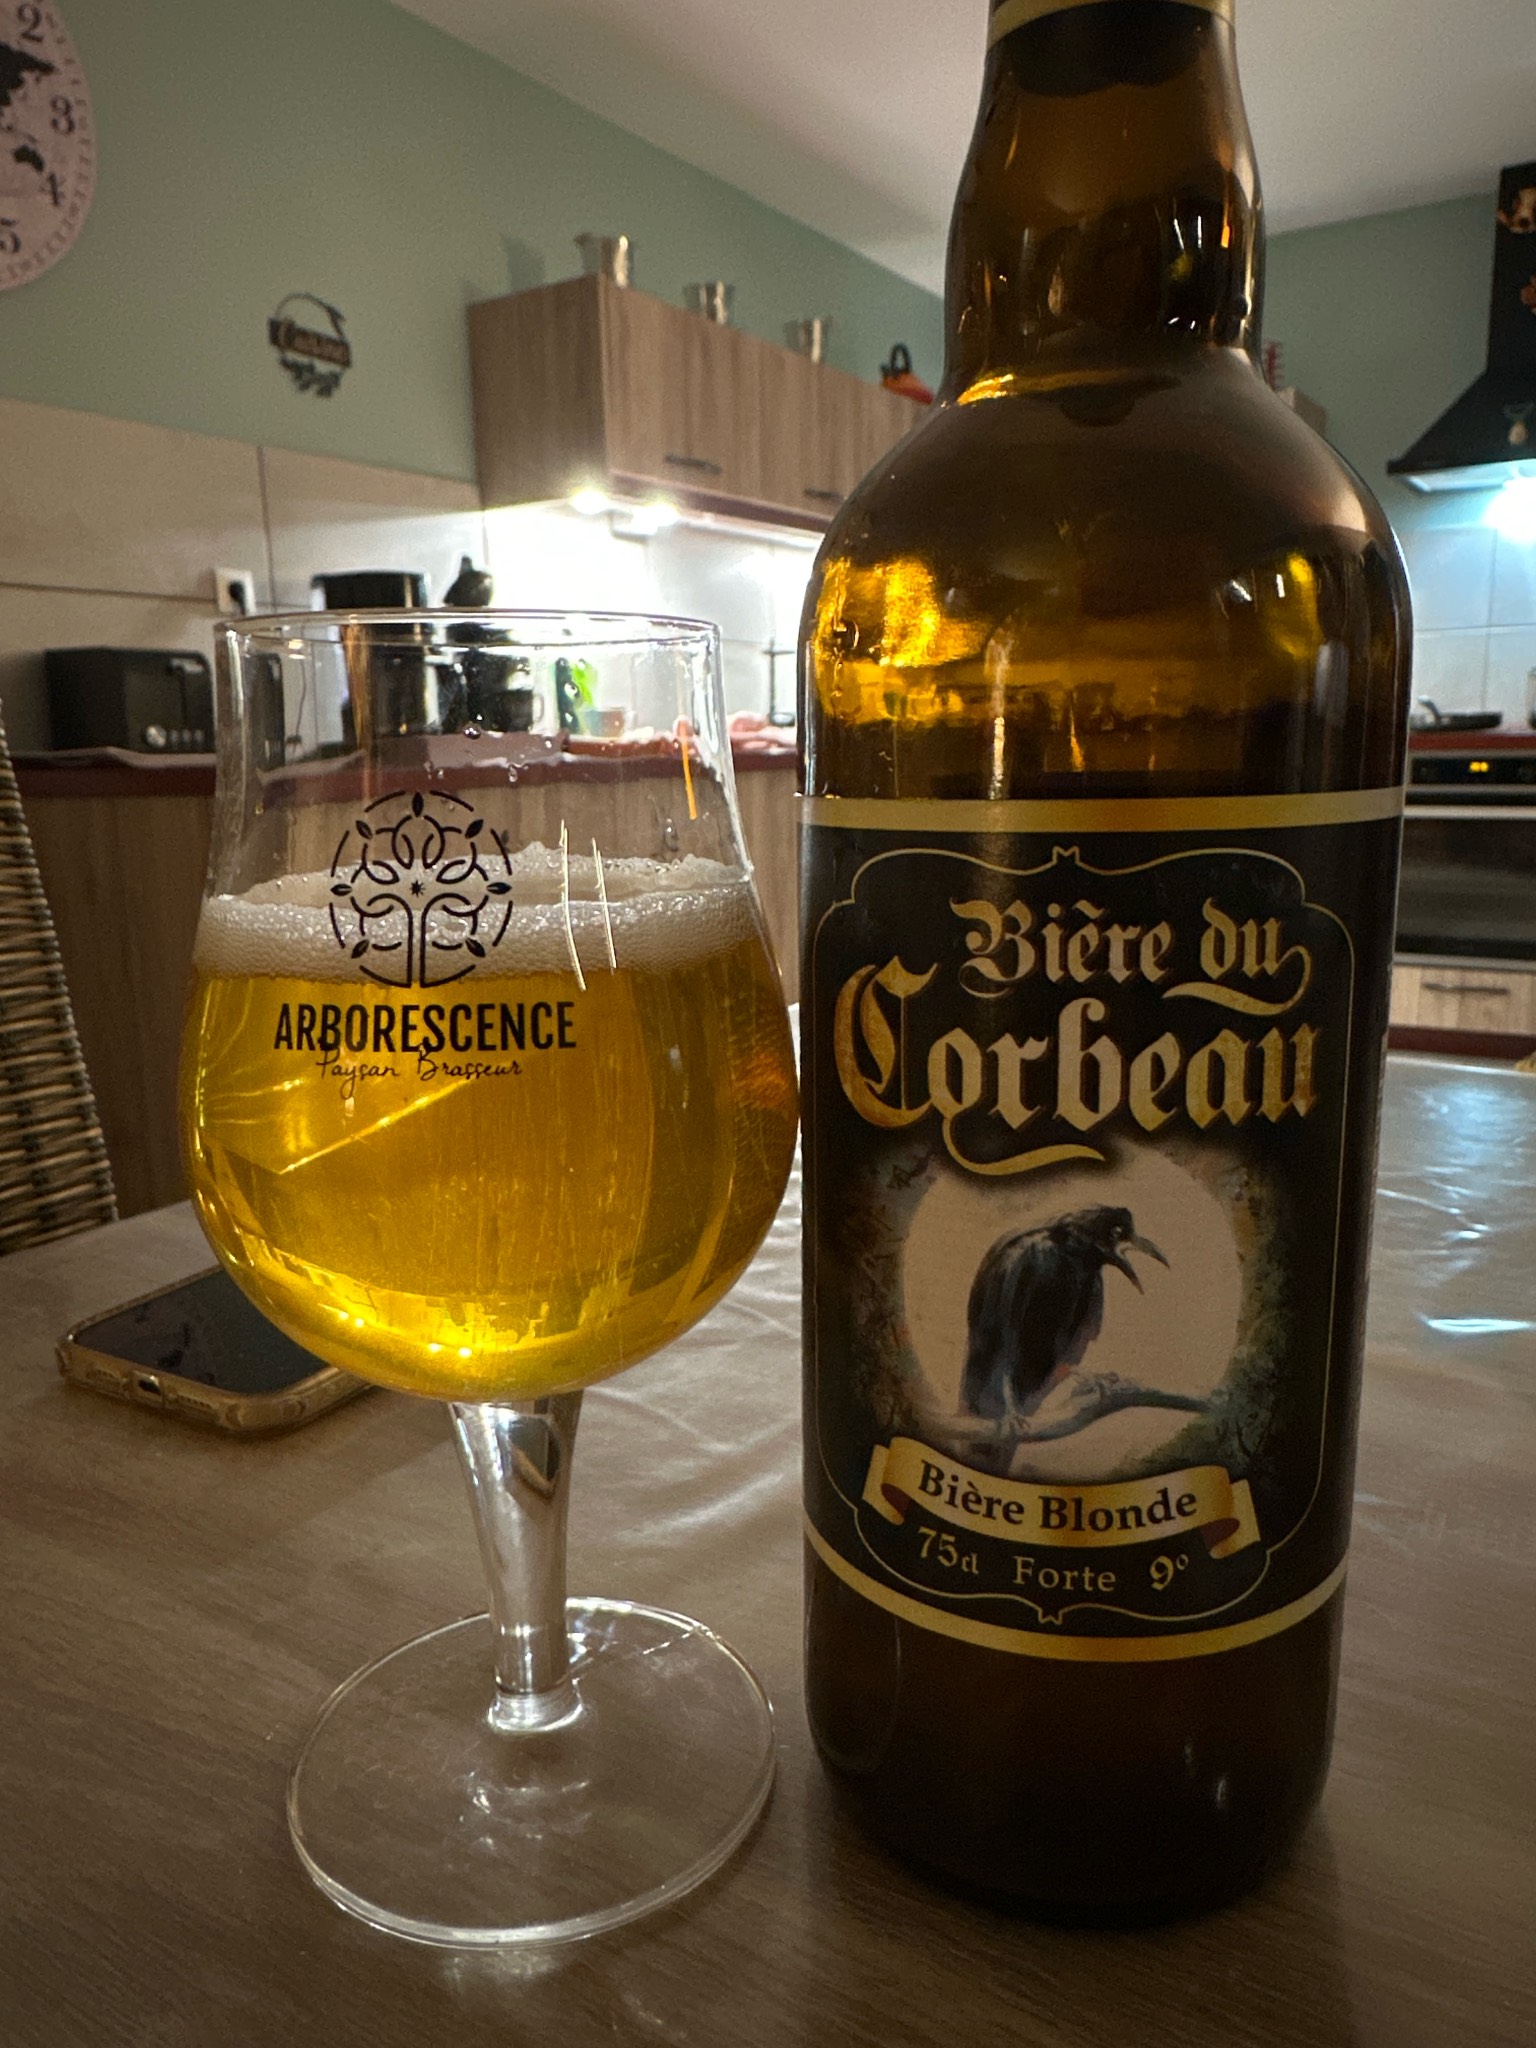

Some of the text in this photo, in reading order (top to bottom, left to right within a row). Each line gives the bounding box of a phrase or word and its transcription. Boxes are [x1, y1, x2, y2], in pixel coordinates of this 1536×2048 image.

[17, 3, 44, 43] 2
[50, 95, 76, 135] 3
[950, 897, 1312, 1016] Bière du
[274, 1001, 577, 1053] ARBORESCENCE
[316, 1036, 522, 1100] Paysan Brasseur
[834, 955, 1322, 1176] Corbeau
[918, 1459, 1198, 1533] Bière Blonde
[1012, 1555, 1118, 1592] Forte
